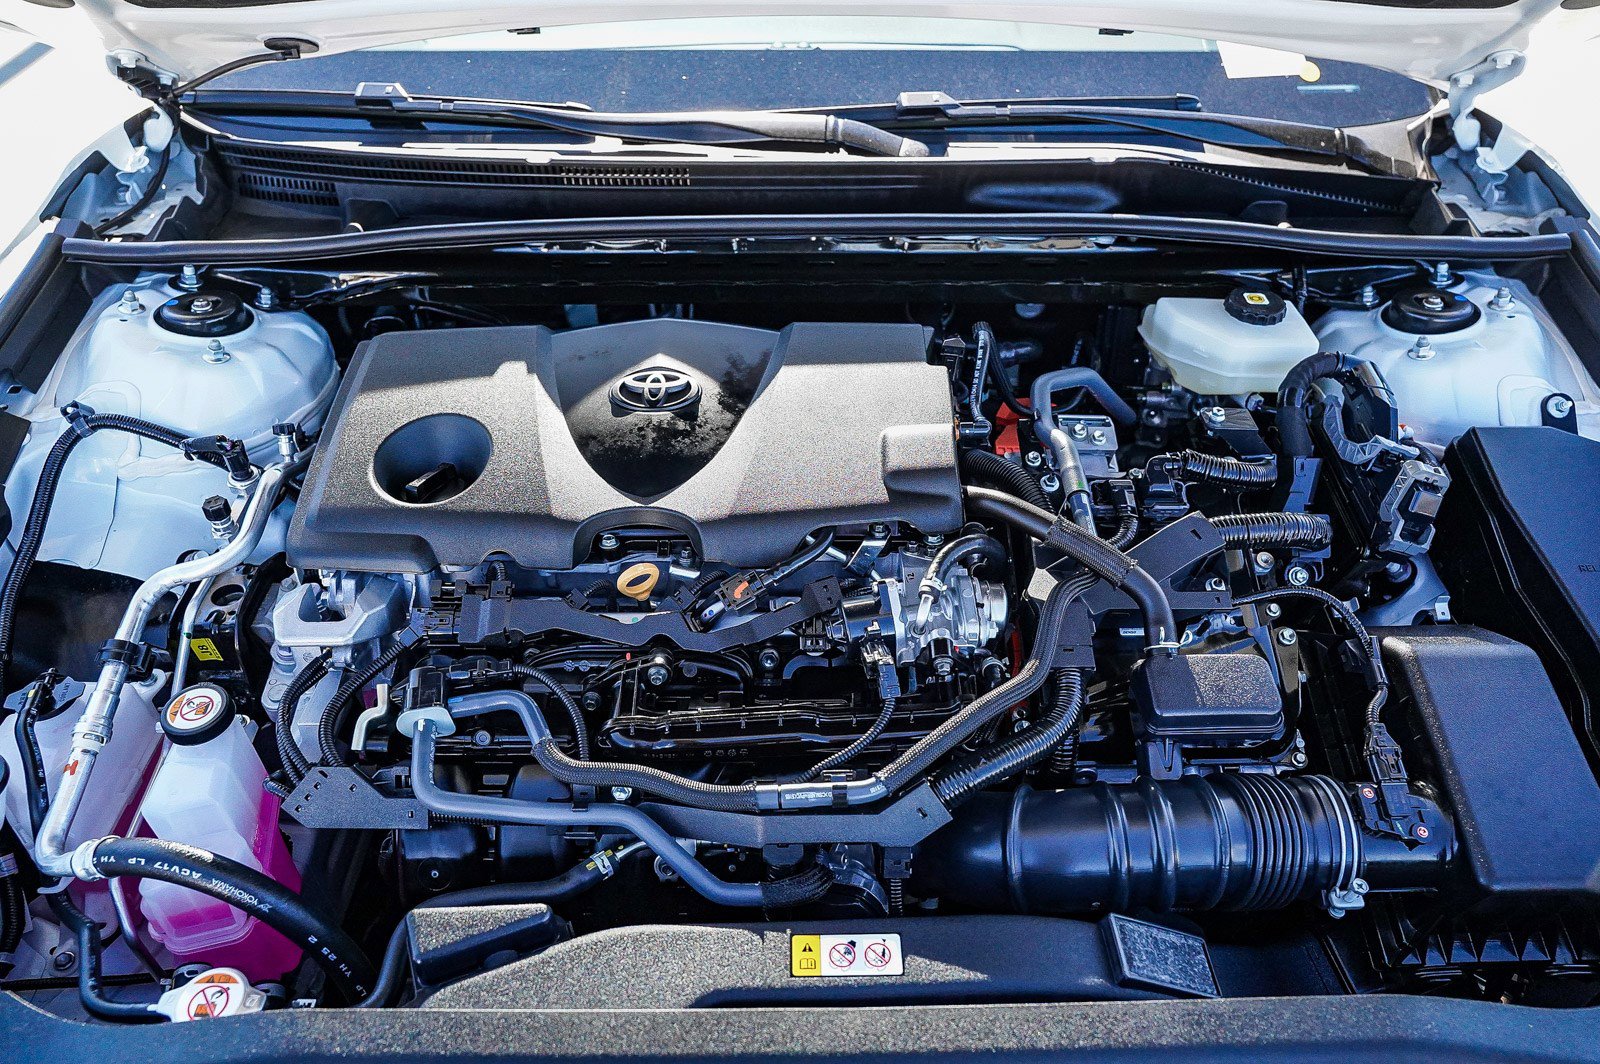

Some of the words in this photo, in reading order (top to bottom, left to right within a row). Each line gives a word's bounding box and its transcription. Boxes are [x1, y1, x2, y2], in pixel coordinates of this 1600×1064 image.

[198, 645, 212, 656] J8
[100, 855, 116, 863] YH
[127, 857, 146, 866] LP
[153, 861, 202, 879] ACV17
[211, 878, 259, 906] YOKOHAMA
[320, 946, 337, 961] 25
[338, 963, 352, 978] YH
[355, 984, 367, 997] LP
